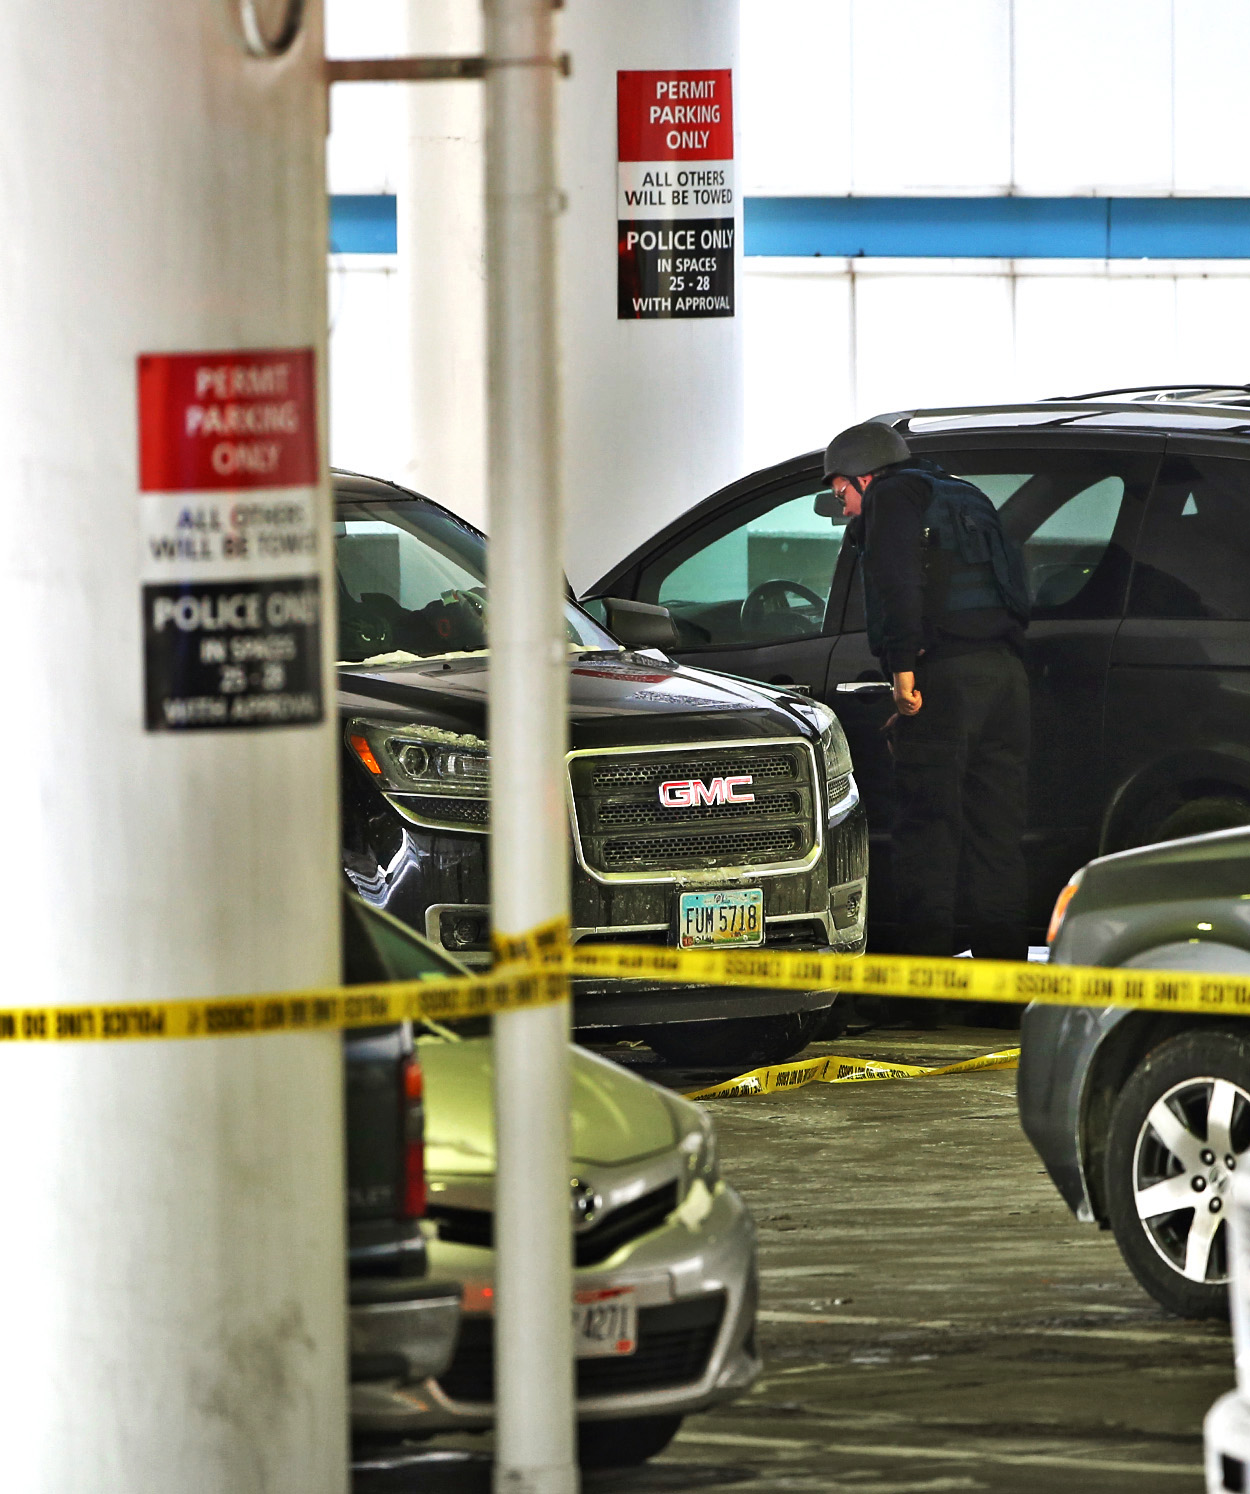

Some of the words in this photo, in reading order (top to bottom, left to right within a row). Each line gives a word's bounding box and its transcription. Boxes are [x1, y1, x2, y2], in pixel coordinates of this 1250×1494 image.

[656, 80, 716, 99] PERMIT
[649, 105, 720, 124] PARKING
[666, 130, 710, 149] ONLY
[642, 172, 672, 187] ALL
[677, 170, 725, 186] OTHERS
[624, 190, 666, 206] WILL
[672, 190, 688, 205] BE
[693, 189, 733, 205] TOWED
[626, 231, 696, 251] POLICE
[700, 229, 734, 249] ONLY
[657, 259, 672, 273] IN
[676, 257, 717, 272] SPACES
[669, 276, 685, 291] 25
[696, 275, 710, 291] 28
[632, 297, 671, 312] WITH
[675, 296, 730, 311] APPROVAL
[195, 364, 290, 399] PERMIT
[184, 402, 299, 437] PARKING
[211, 443, 281, 475] ONLY
[177, 506, 220, 529] ALL
[150, 535, 211, 561] WILL
[222, 535, 248, 560] BE
[153, 595, 261, 633] POLICE
[266, 591, 318, 627] ONL
[200, 637, 227, 664] IN
[658, 775, 756, 808] GMC
[686, 907, 714, 935] FUM
[719, 904, 757, 933] 5718
[581, 1303, 629, 1342] 4271
